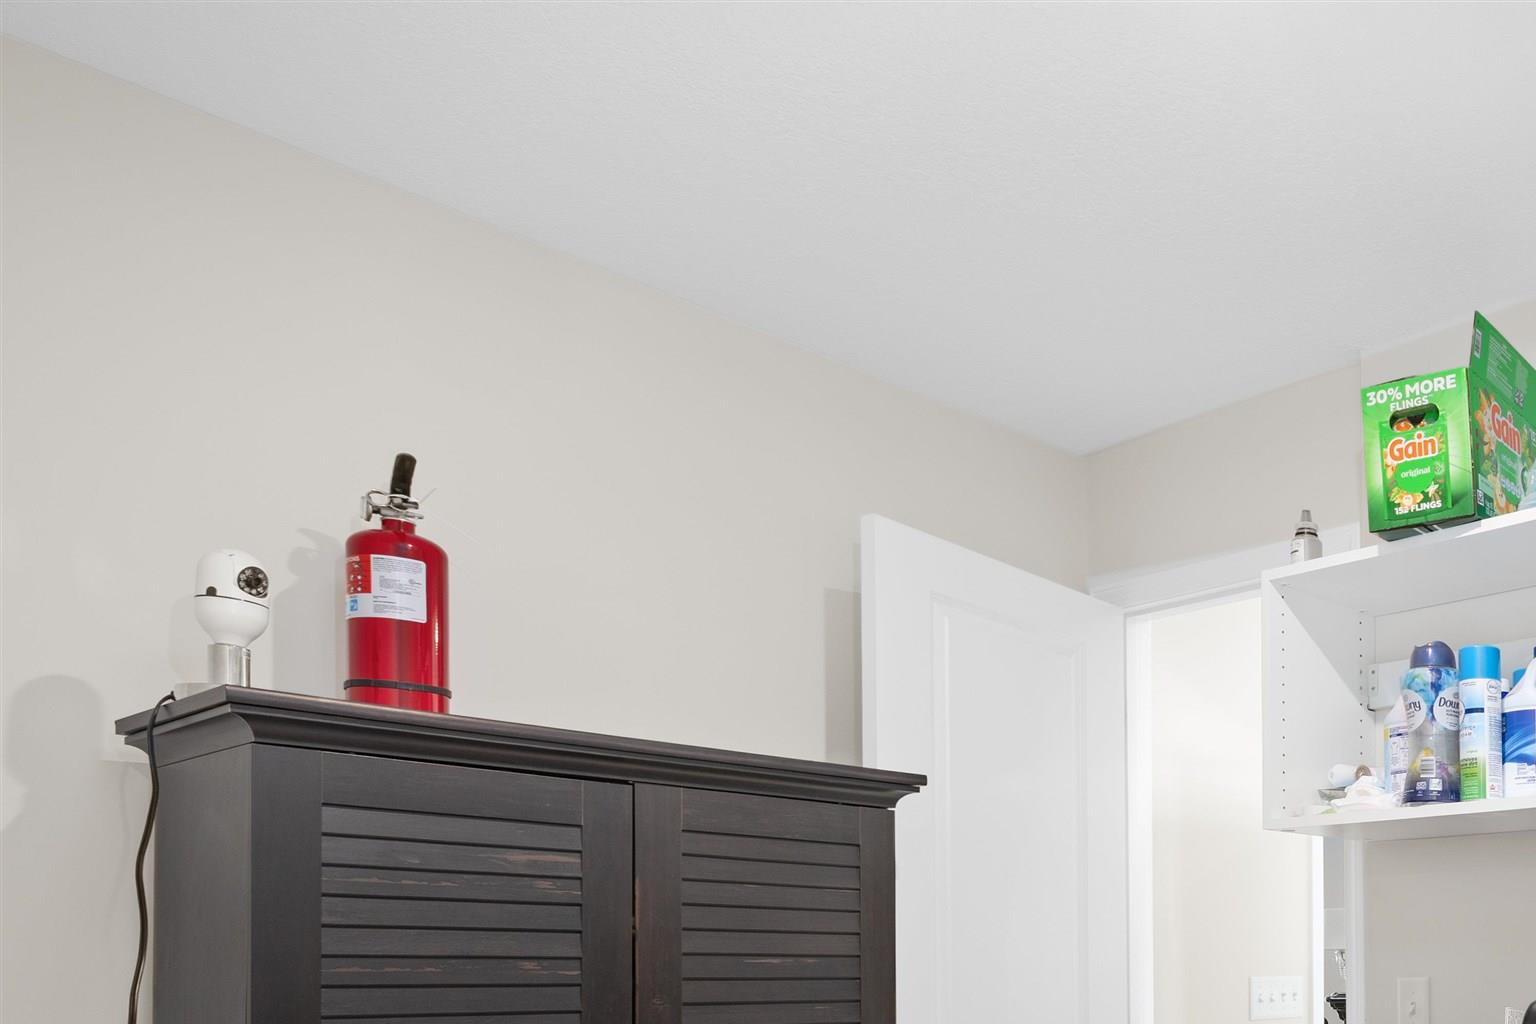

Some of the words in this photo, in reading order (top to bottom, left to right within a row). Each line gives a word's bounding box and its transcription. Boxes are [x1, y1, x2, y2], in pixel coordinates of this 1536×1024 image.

[1366, 386, 1402, 406] 30%
[1405, 374, 1457, 398] MORE
[1390, 395, 1429, 412] FLINGS
[1491, 402, 1521, 456] Gain
[1388, 430, 1438, 463] Gain
[1401, 466, 1431, 479] original
[1410, 500, 1442, 513] FLINGS
